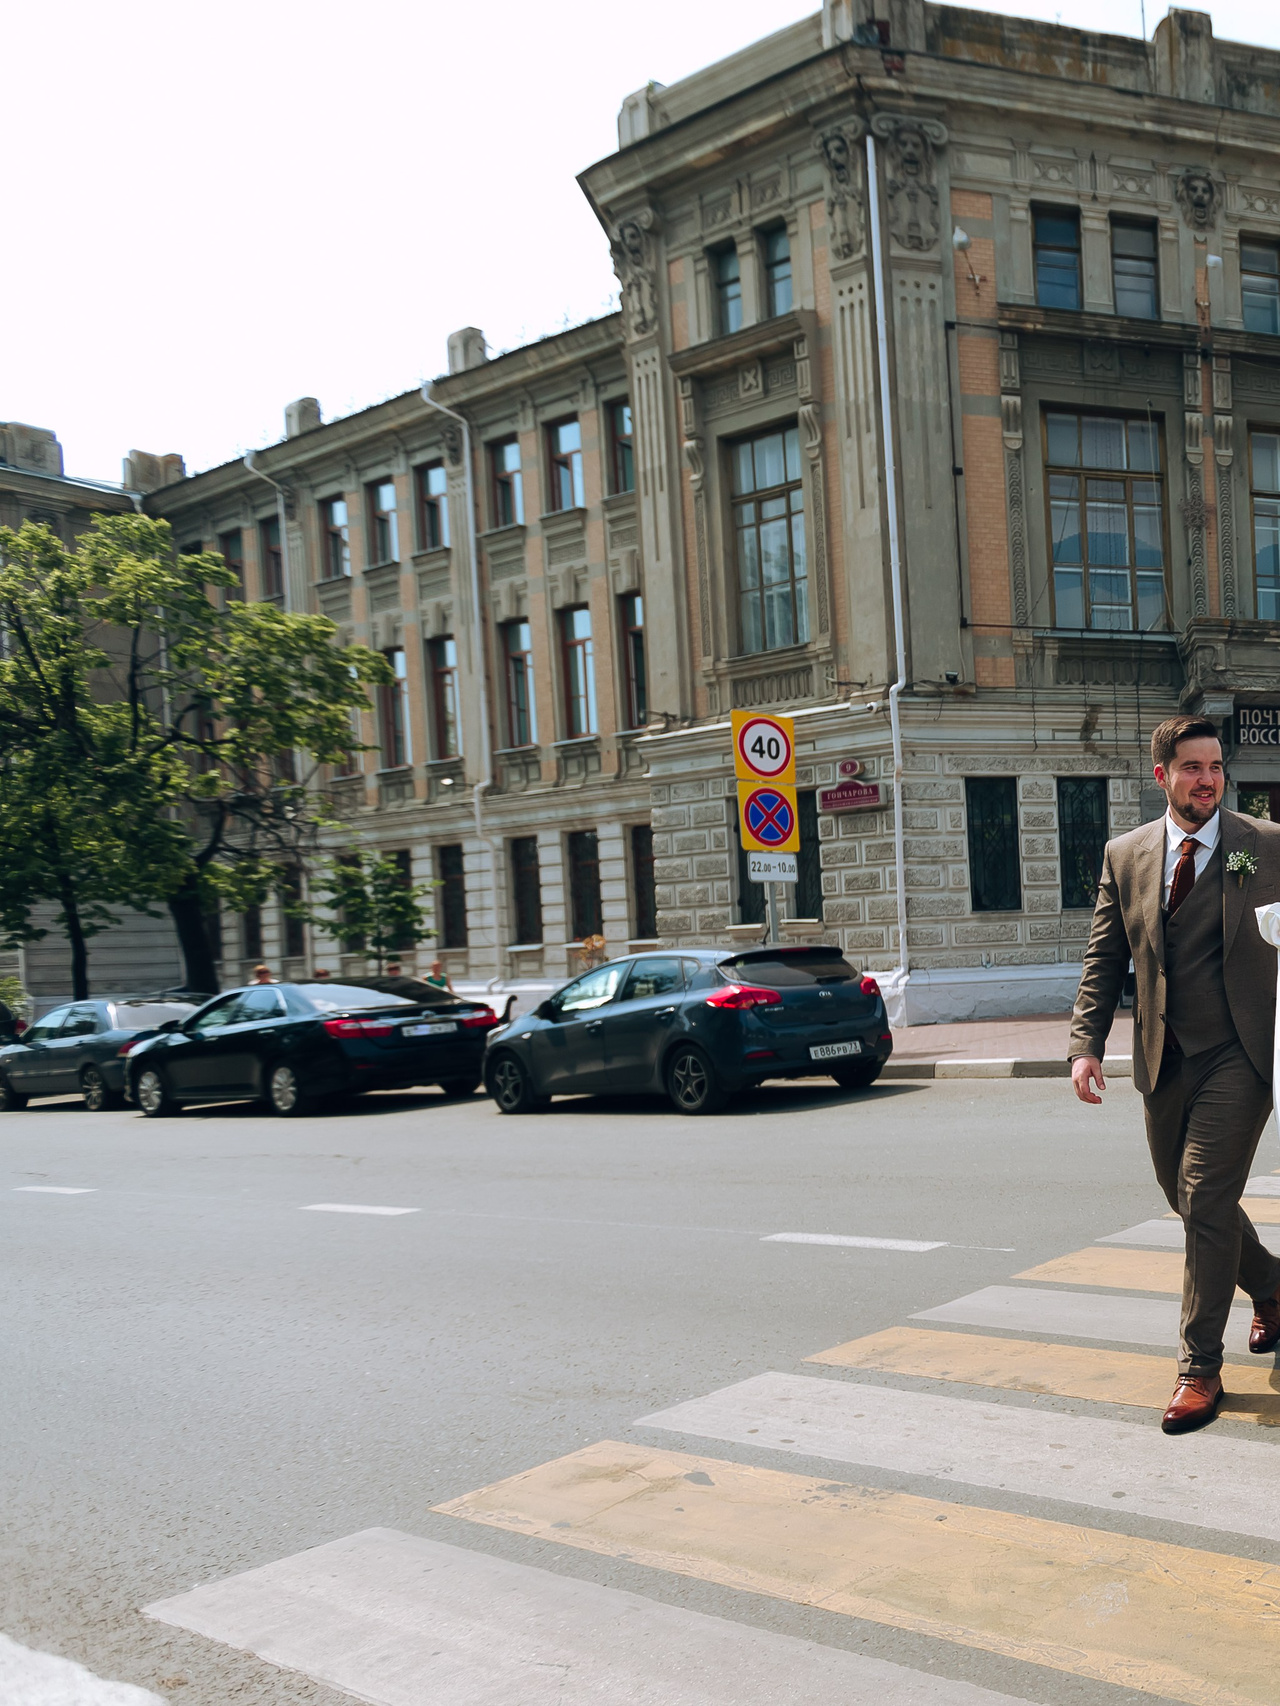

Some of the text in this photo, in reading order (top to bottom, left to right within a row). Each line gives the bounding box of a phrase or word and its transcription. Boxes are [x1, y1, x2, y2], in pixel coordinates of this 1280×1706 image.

[751, 735, 780, 760] 40
[845, 763, 851, 772] 9
[827, 787, 873, 800] ГОНЧАРОВА
